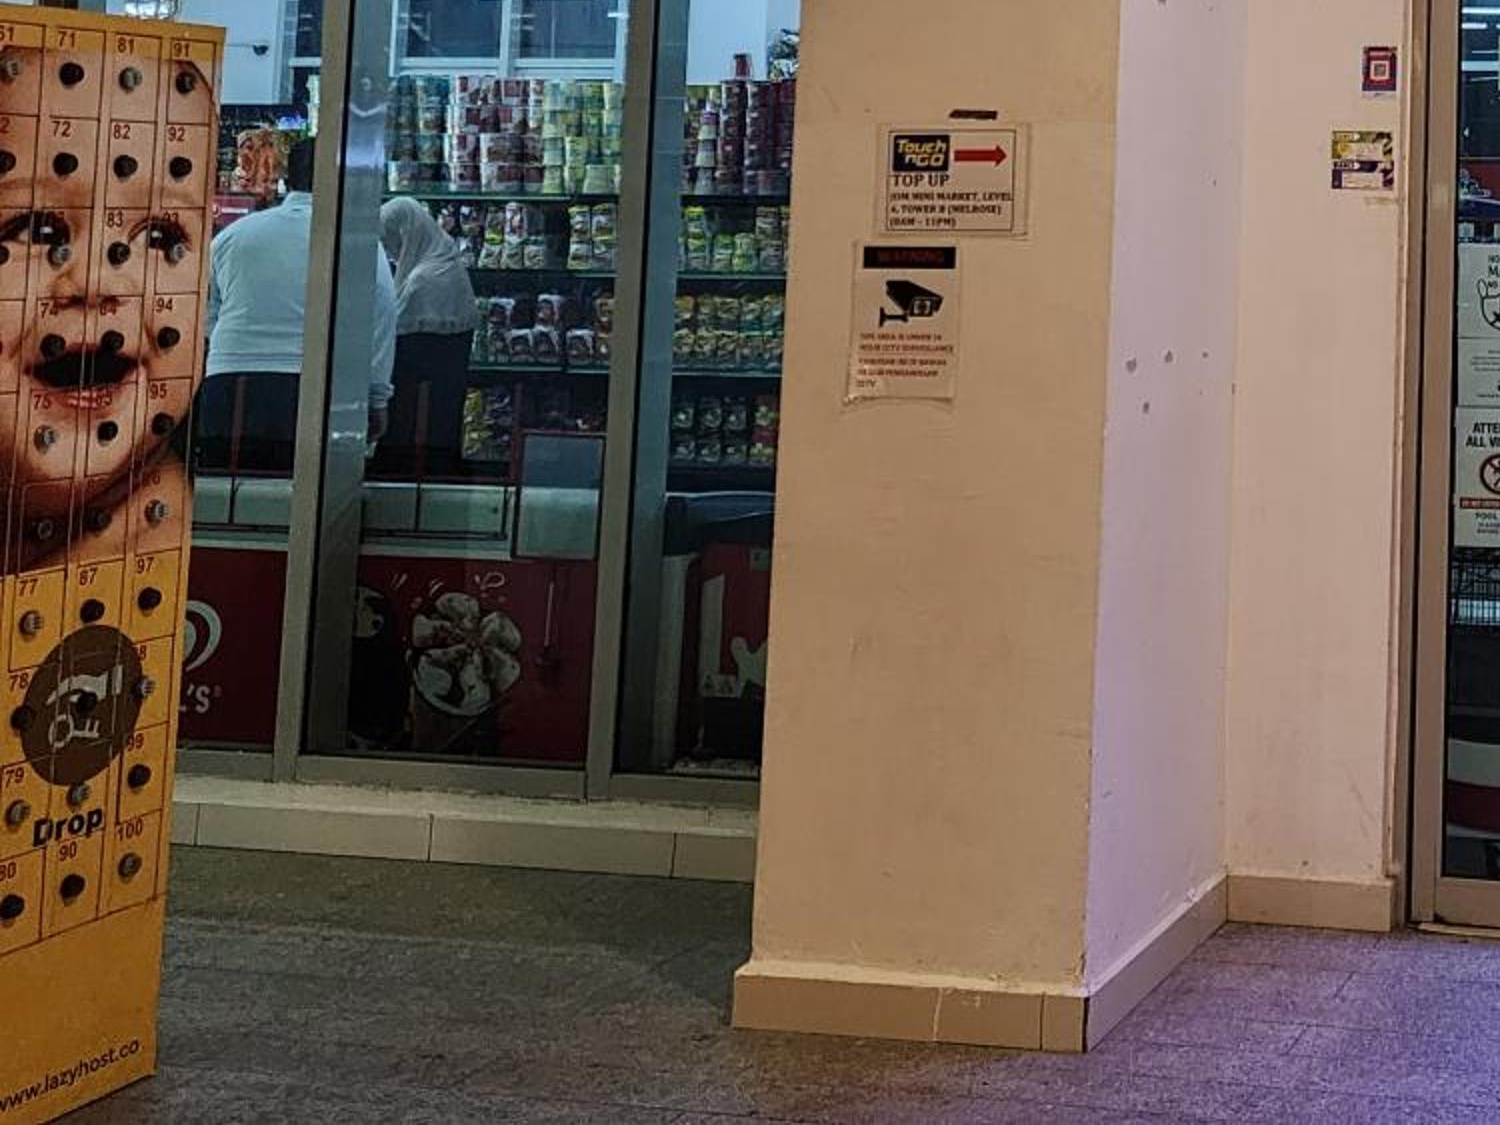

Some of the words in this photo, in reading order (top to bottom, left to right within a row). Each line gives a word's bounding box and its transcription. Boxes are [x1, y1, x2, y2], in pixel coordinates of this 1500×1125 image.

[58, 32, 76, 47] 71
[117, 38, 134, 54] 81
[173, 43, 190, 58] 91
[53, 121, 71, 138] 72
[113, 125, 131, 140] 82
[168, 126, 185, 142] 92
[896, 139, 946, 153] Touch
[893, 174, 924, 187] TOP
[928, 174, 949, 187] UP
[983, 192, 1014, 202] LEVEL
[902, 205, 936, 214] TOWER
[107, 212, 124, 227] 83
[1488, 255, 1500, 264] NO
[155, 297, 173, 312] 94
[150, 384, 167, 400] 95
[1466, 437, 1486, 448] ALL
[19, 578, 38, 596] 77
[137, 557, 154, 574] 97
[9, 673, 30, 691] 78
[5, 767, 25, 788] 79
[33, 808, 103, 848] Drop
[59, 841, 77, 861] 90
[116, 818, 143, 841] 100
